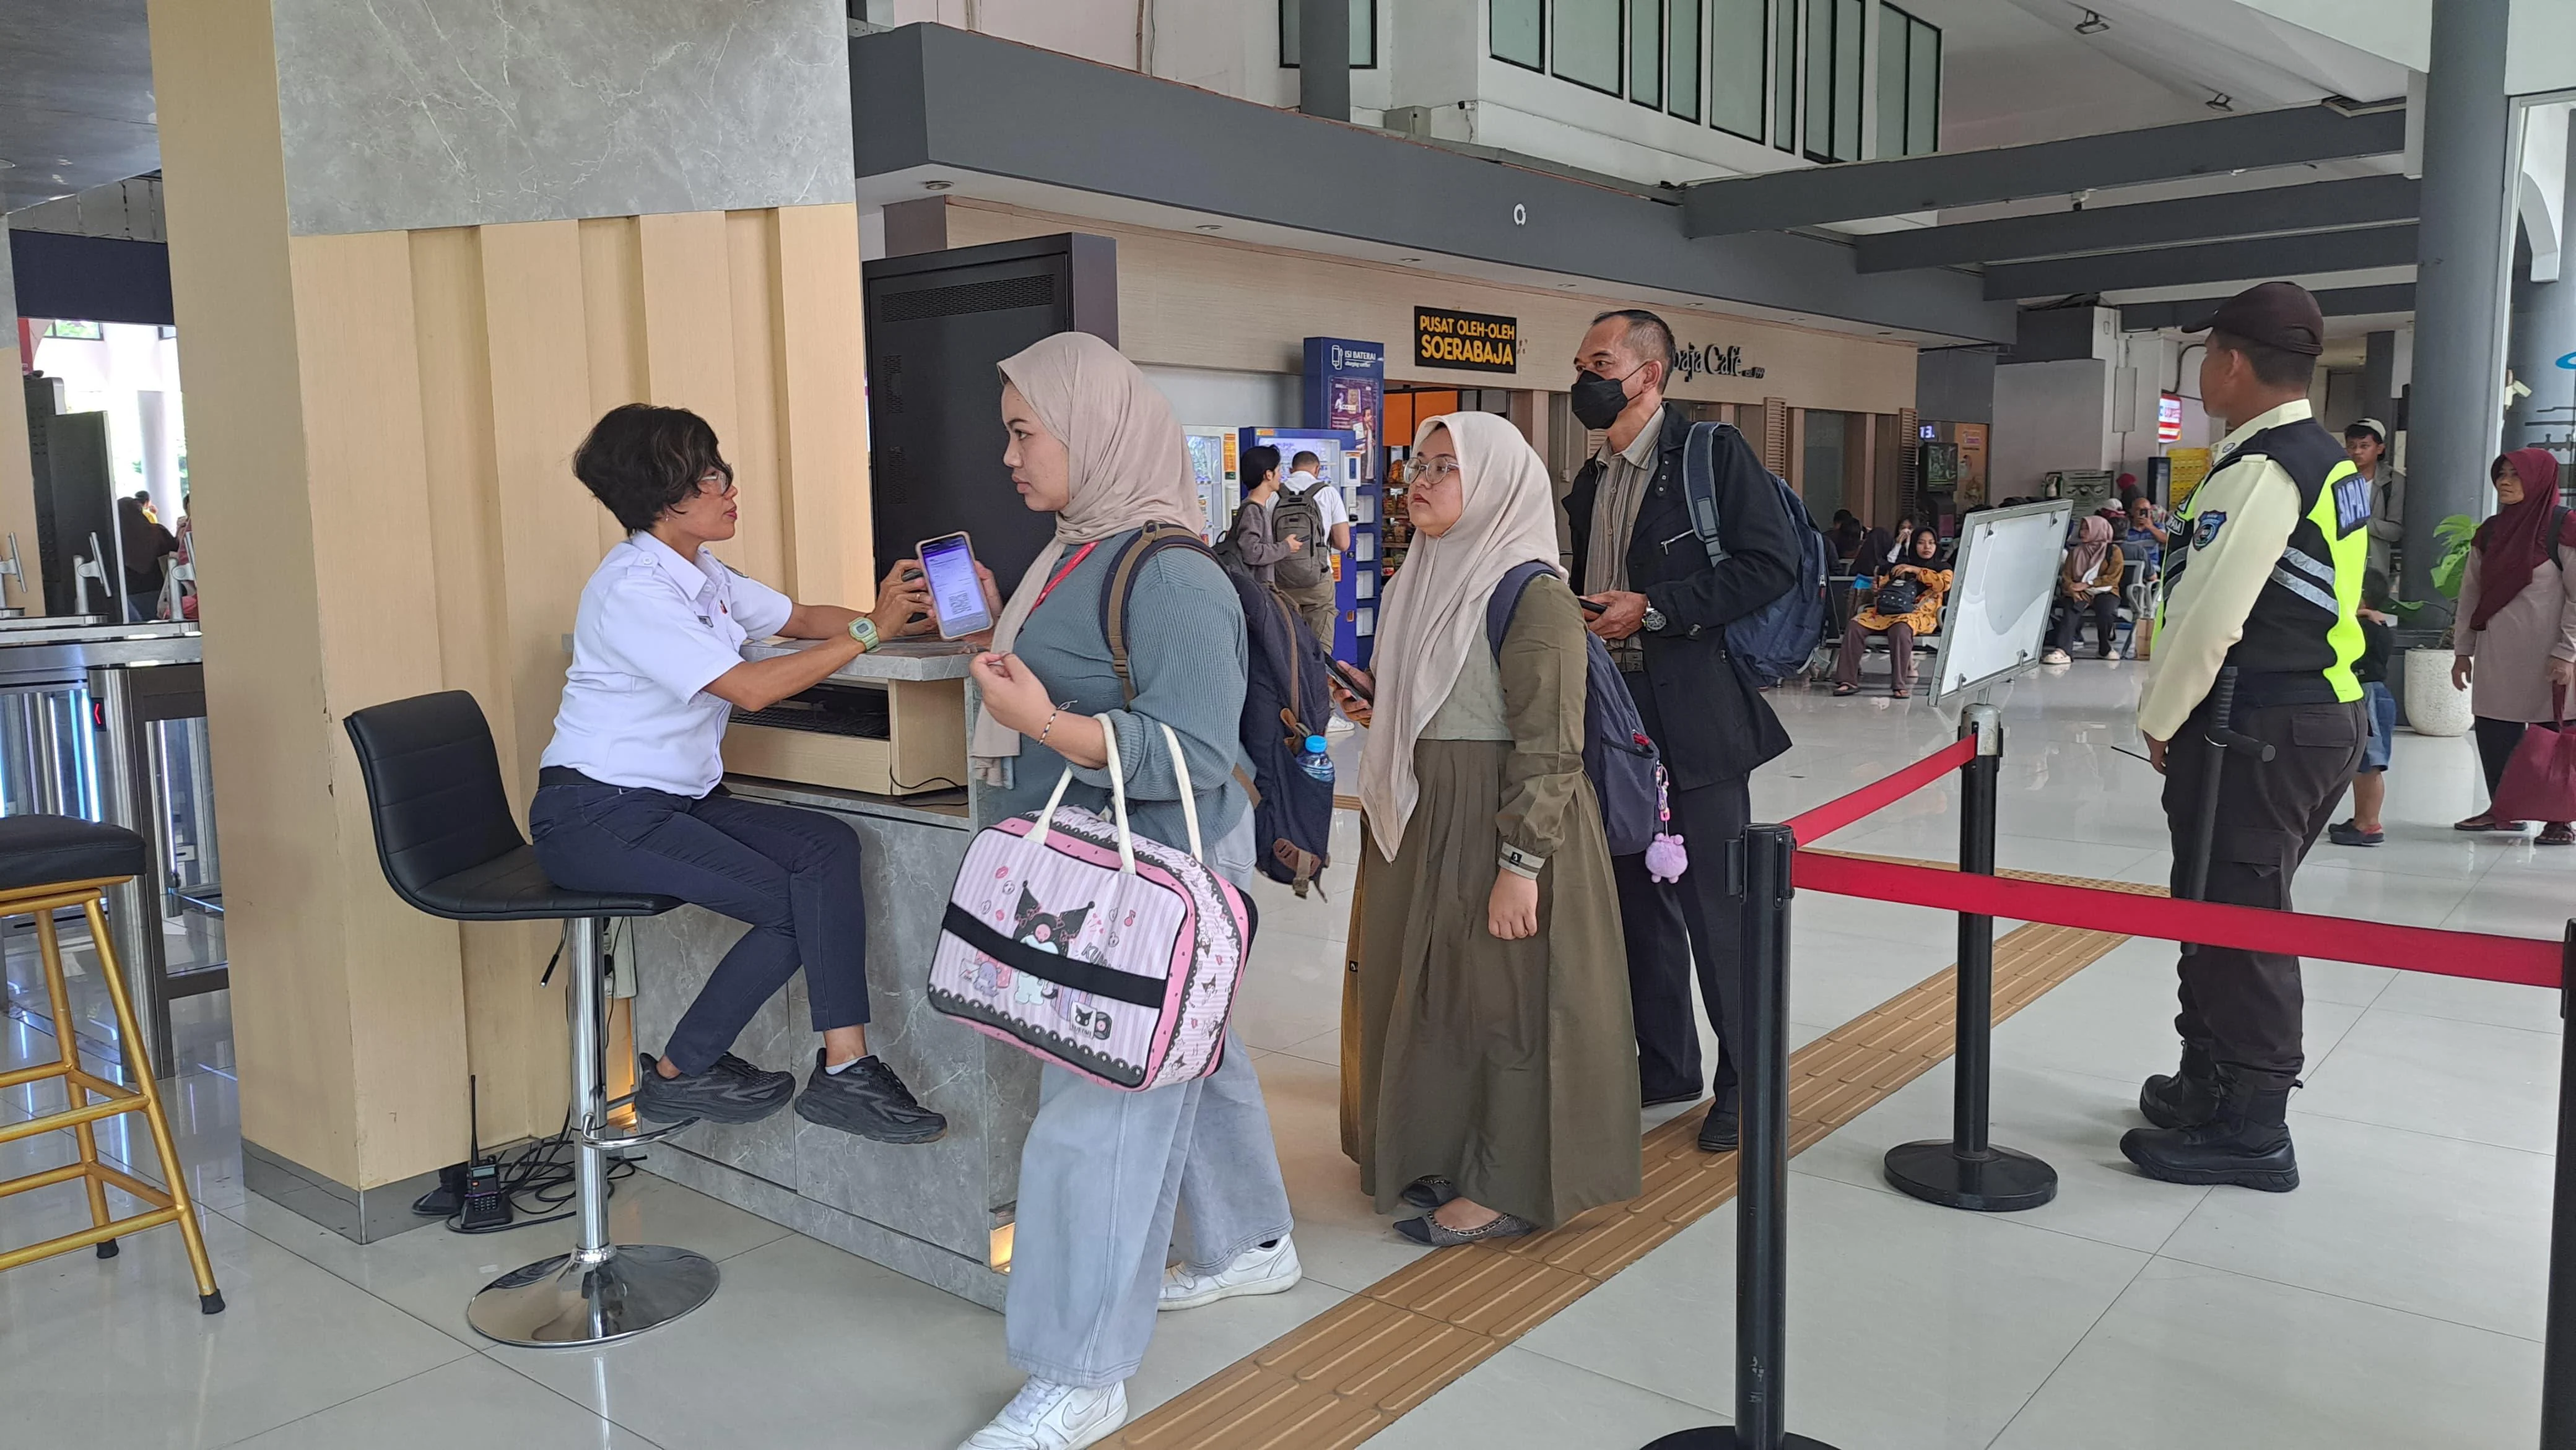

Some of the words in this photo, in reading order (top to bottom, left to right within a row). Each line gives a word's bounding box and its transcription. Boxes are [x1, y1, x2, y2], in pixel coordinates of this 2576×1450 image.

[1420, 315, 1455, 334] PUSAT
[1457, 319, 1515, 340] OLEH-OLEH
[1352, 351, 1376, 360] BATERAI
[1421, 334, 1514, 365] SOERABAJA
[1704, 343, 1742, 376] Café
